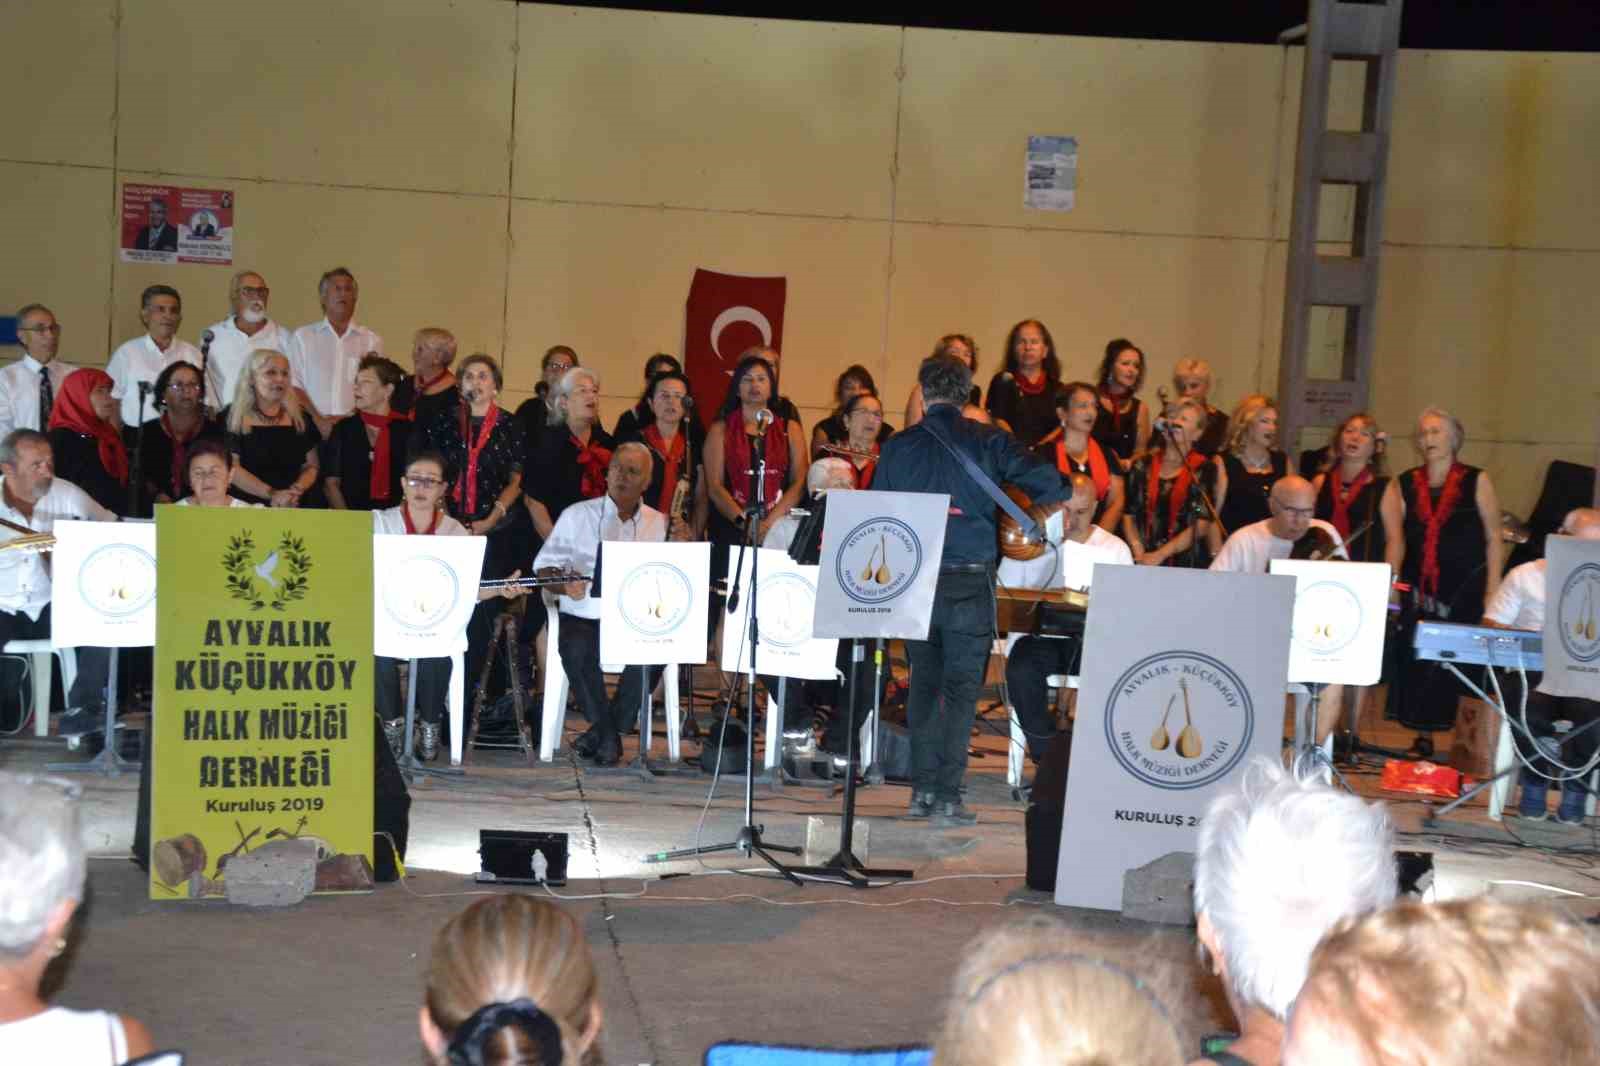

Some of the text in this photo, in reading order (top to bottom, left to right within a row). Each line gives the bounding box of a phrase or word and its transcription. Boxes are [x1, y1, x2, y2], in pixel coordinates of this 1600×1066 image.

[204, 618, 332, 647] AYVALIK
[175, 652, 356, 694] KÜÇÜKKÖY
[1124, 664, 1169, 697] AYVALIK
[184, 702, 348, 741] HALK MÜZİĞİ
[1121, 731, 1142, 760] HALK
[200, 748, 331, 788] DERNEĞİ
[206, 798, 324, 814] Kuruluş 2019
[1115, 809, 1184, 827] KURULUŞ
